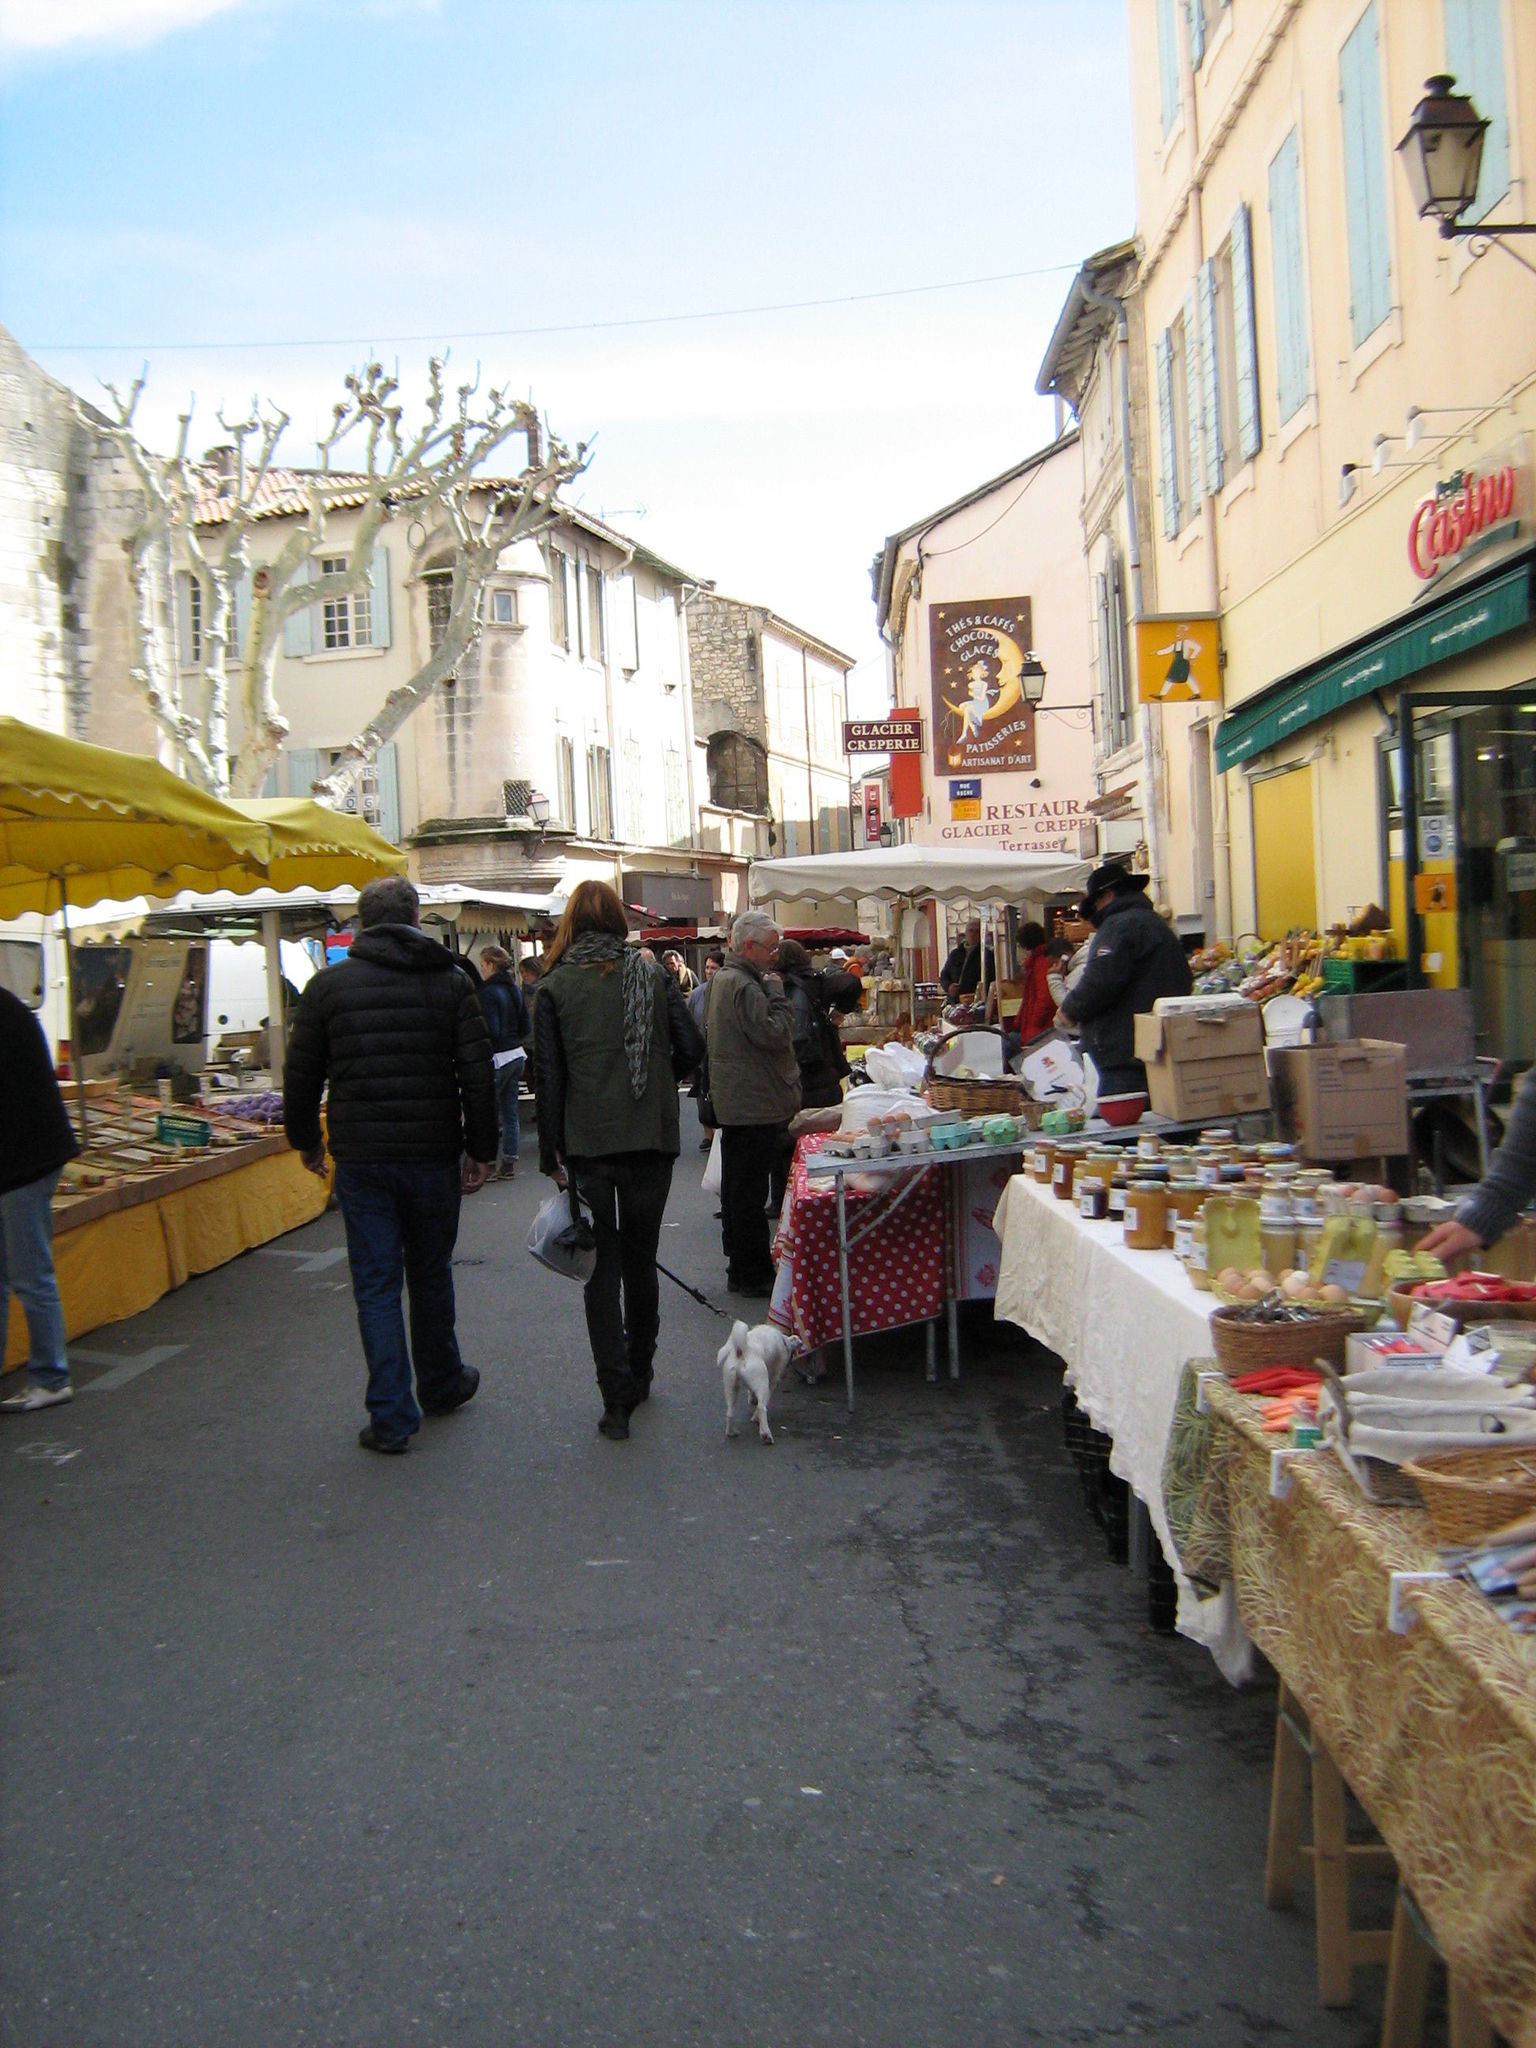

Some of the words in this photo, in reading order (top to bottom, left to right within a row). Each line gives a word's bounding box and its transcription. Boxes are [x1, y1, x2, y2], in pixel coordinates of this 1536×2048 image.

[1408, 466, 1514, 579] Casino
[945, 617, 973, 637] THÉS
[974, 615, 981, 625] &
[983, 615, 1015, 633] CAFÉS
[960, 644, 999, 662] GLACES
[851, 723, 914, 736] GLACIER
[966, 720, 1026, 753] PATISSERIES
[847, 738, 919, 751] CREPERIE
[962, 756, 1005, 767] ARTISANAT
[1008, 754, 1032, 765] D'ART
[986, 800, 1088, 821] RESTAUR
[942, 823, 1012, 839] GLACIER
[999, 840, 1060, 852] Terrasse
